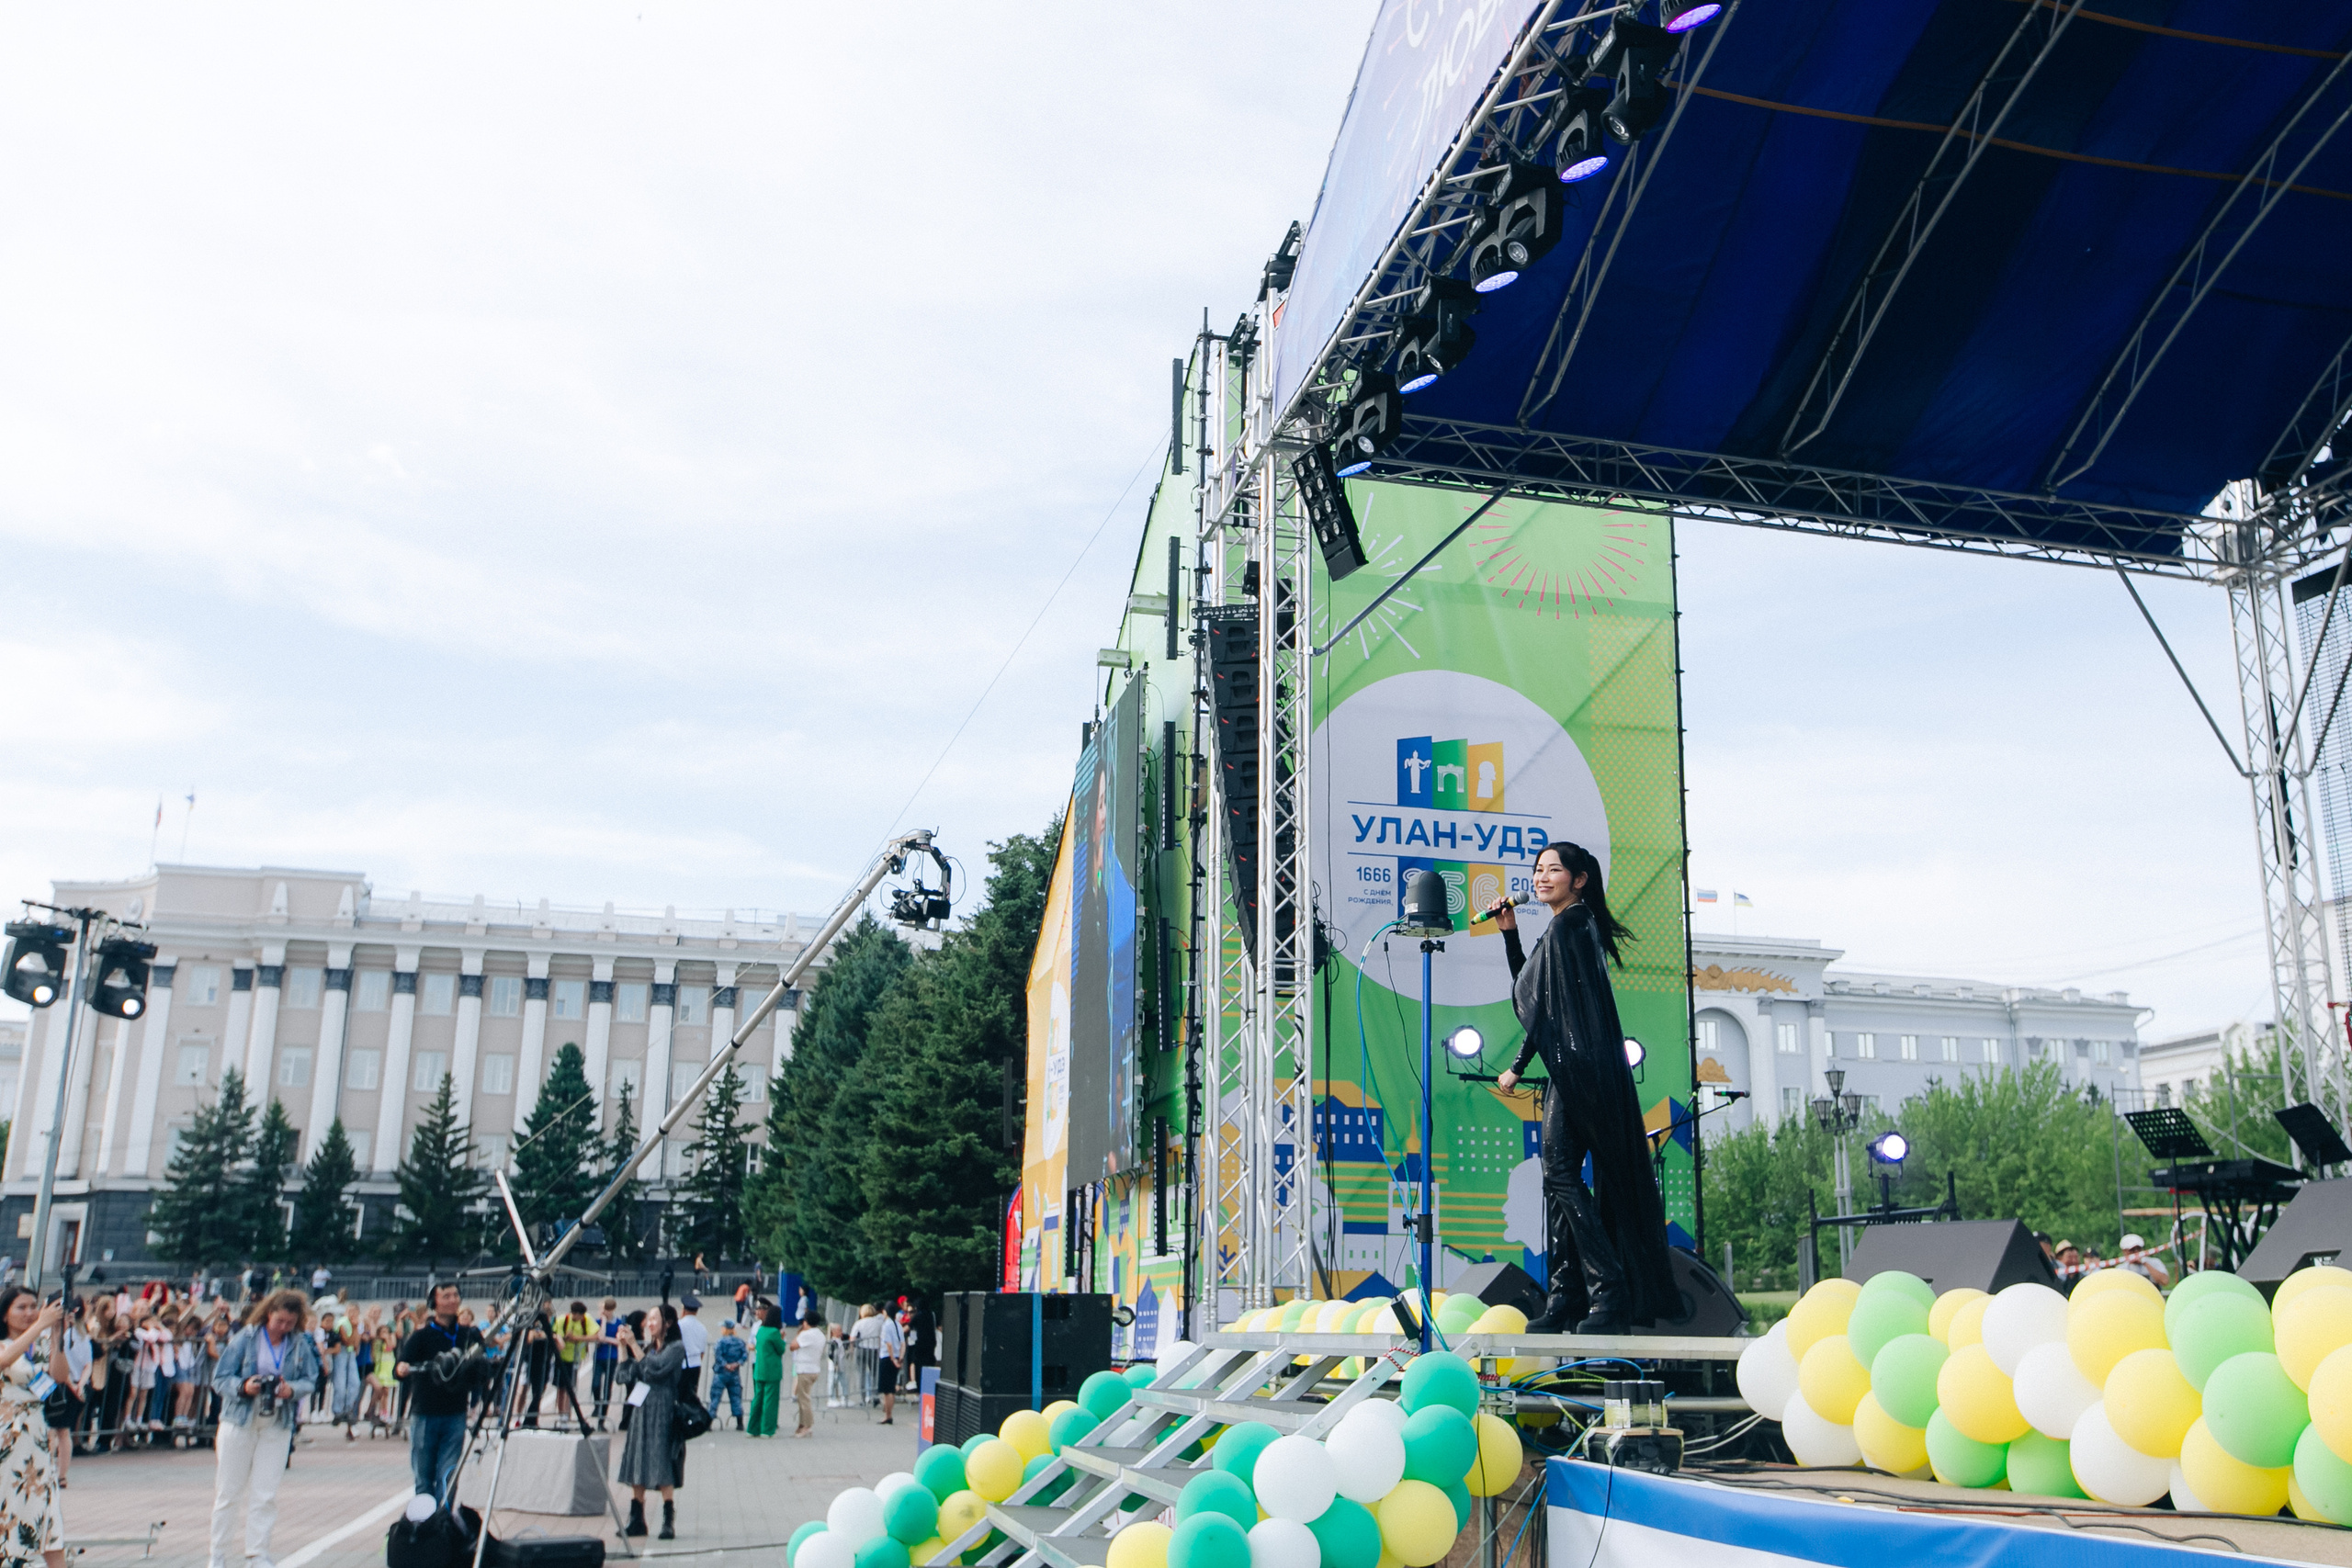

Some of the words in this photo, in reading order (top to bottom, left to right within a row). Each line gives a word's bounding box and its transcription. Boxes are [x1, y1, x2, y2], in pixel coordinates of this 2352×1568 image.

[1351, 814, 1548, 861] УЛАН-УДЭ
[1356, 866, 1391, 883] 1666
[1401, 867, 1500, 915] 56
